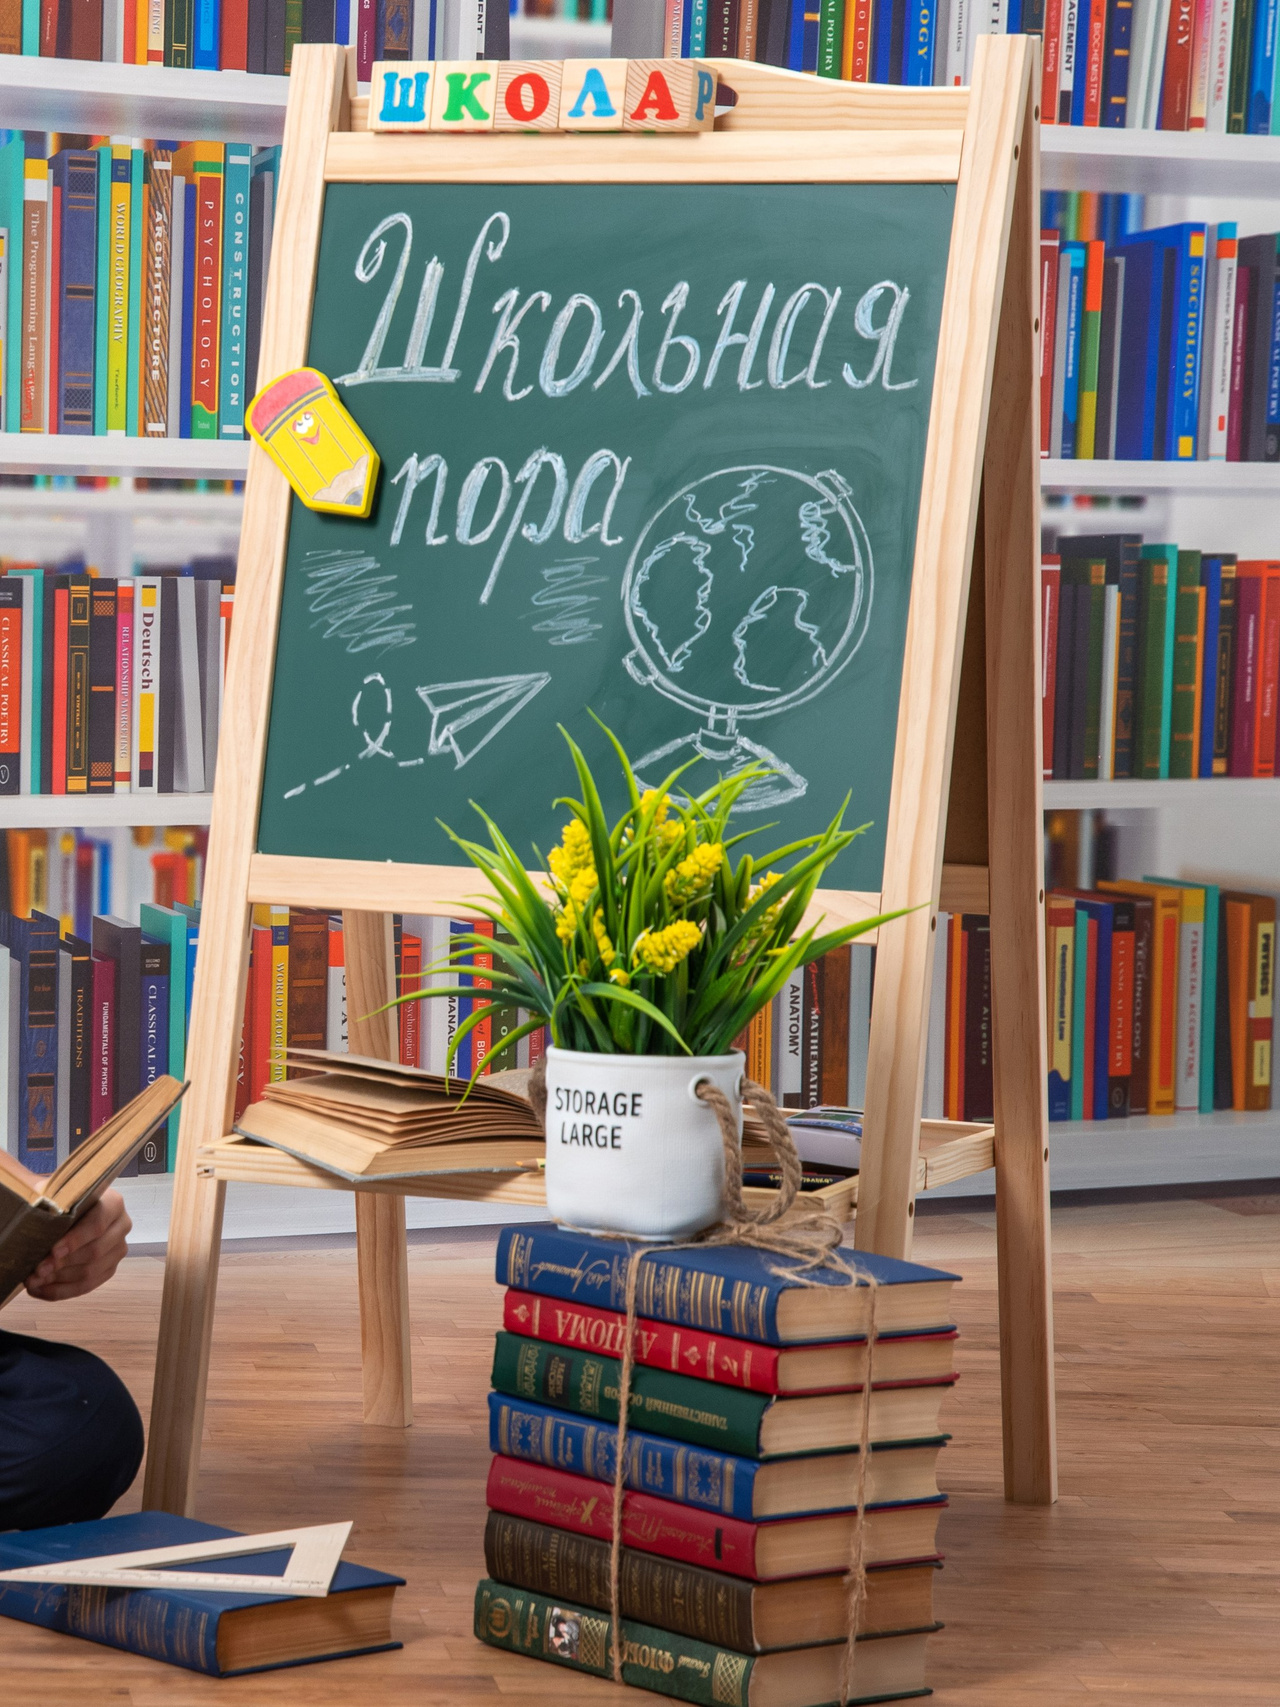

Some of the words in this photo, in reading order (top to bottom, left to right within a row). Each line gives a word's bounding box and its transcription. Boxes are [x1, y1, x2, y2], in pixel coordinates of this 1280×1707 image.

[825, 19, 835, 73] POETRY
[1047, 38, 1058, 73] Testing
[1088, 22, 1102, 104] BIOCHEMISTRY
[378, 68, 681, 123] ШКОЛА
[31, 210, 40, 237] The
[115, 202, 127, 255] WORLD
[28, 241, 40, 334] Programming
[113, 257, 125, 344] GEOGRAPHY
[150, 210, 164, 381] ARCHITECTURE
[199, 200, 215, 389] PSYCHOLOGY
[229, 192, 245, 406] CONSTRUCTION
[332, 211, 920, 401] Школьная
[1183, 264, 1201, 401] SOCIOLOGY
[390, 446, 633, 607] пора
[1, 616, 11, 692] CLASSICAL
[120, 626, 131, 698] RELATIONSHIP
[140, 612, 155, 691] Deutsch
[0, 694, 10, 746] POETRY
[119, 699, 129, 760] MARKETING
[275, 962, 285, 1007] WORLD
[1188, 930, 1199, 996] FINANCIAL
[1260, 932, 1272, 997] PHYSICS
[75, 986, 85, 1069] TRADITIONS
[102, 1001, 110, 1056] FUNDAMENTALS
[147, 984, 158, 1064] CLASSICAL
[788, 984, 801, 1057] ANATOMY
[1133, 940, 1147, 1060] TECHNOLOGY
[101, 1057, 108, 1066] OF
[981, 1005, 991, 1066] Algebra
[101, 1066, 109, 1097] PHYSICS
[555, 1087, 643, 1117] STORAGE
[561, 1122, 622, 1149] LARGE
[604, 1385, 644, 1408] ОСРОВ
[645, 1396, 729, 1431] ТАИНСТВЕННЫЙ
